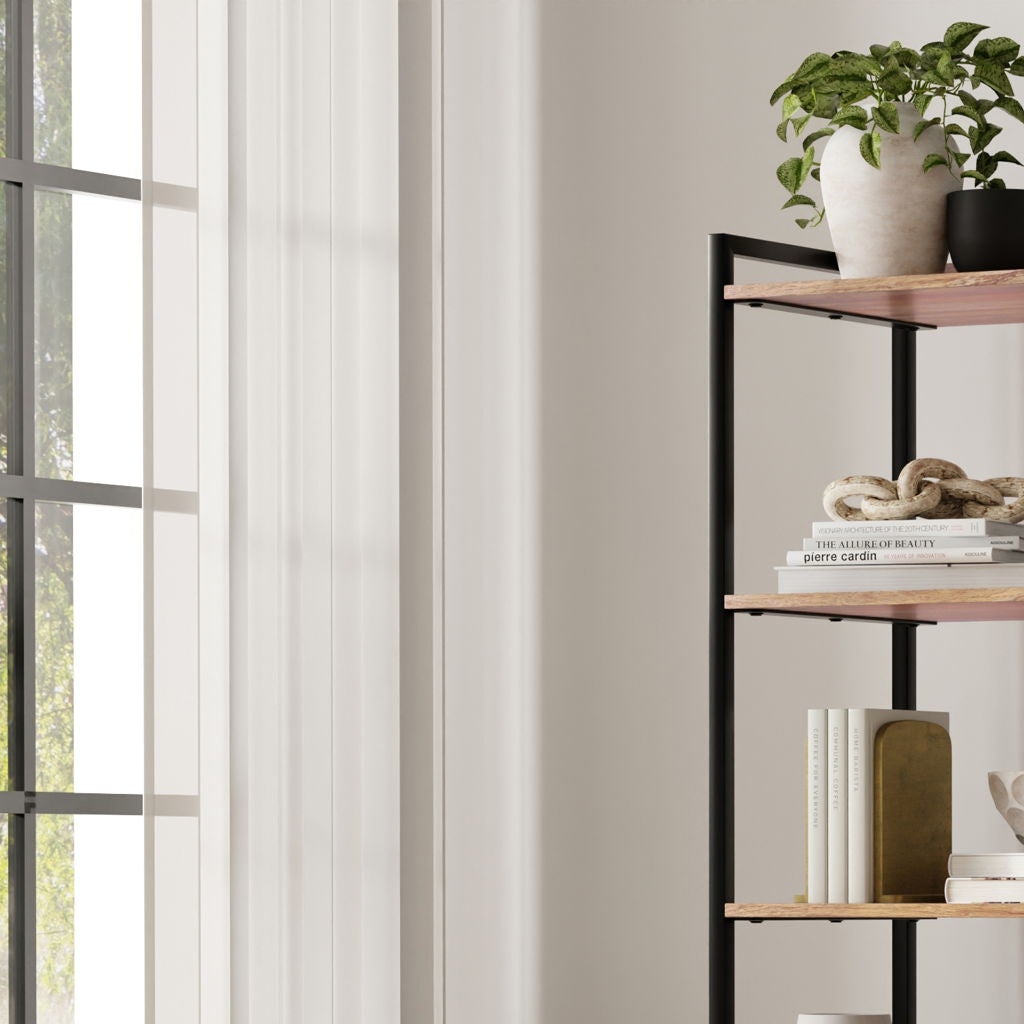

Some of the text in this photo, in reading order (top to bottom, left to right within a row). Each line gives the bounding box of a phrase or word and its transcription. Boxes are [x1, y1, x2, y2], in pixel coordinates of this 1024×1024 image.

[816, 539, 935, 548] THE ALLURE OF BEAUTY
[804, 551, 837, 564] pierre
[841, 551, 877, 561] cardin
